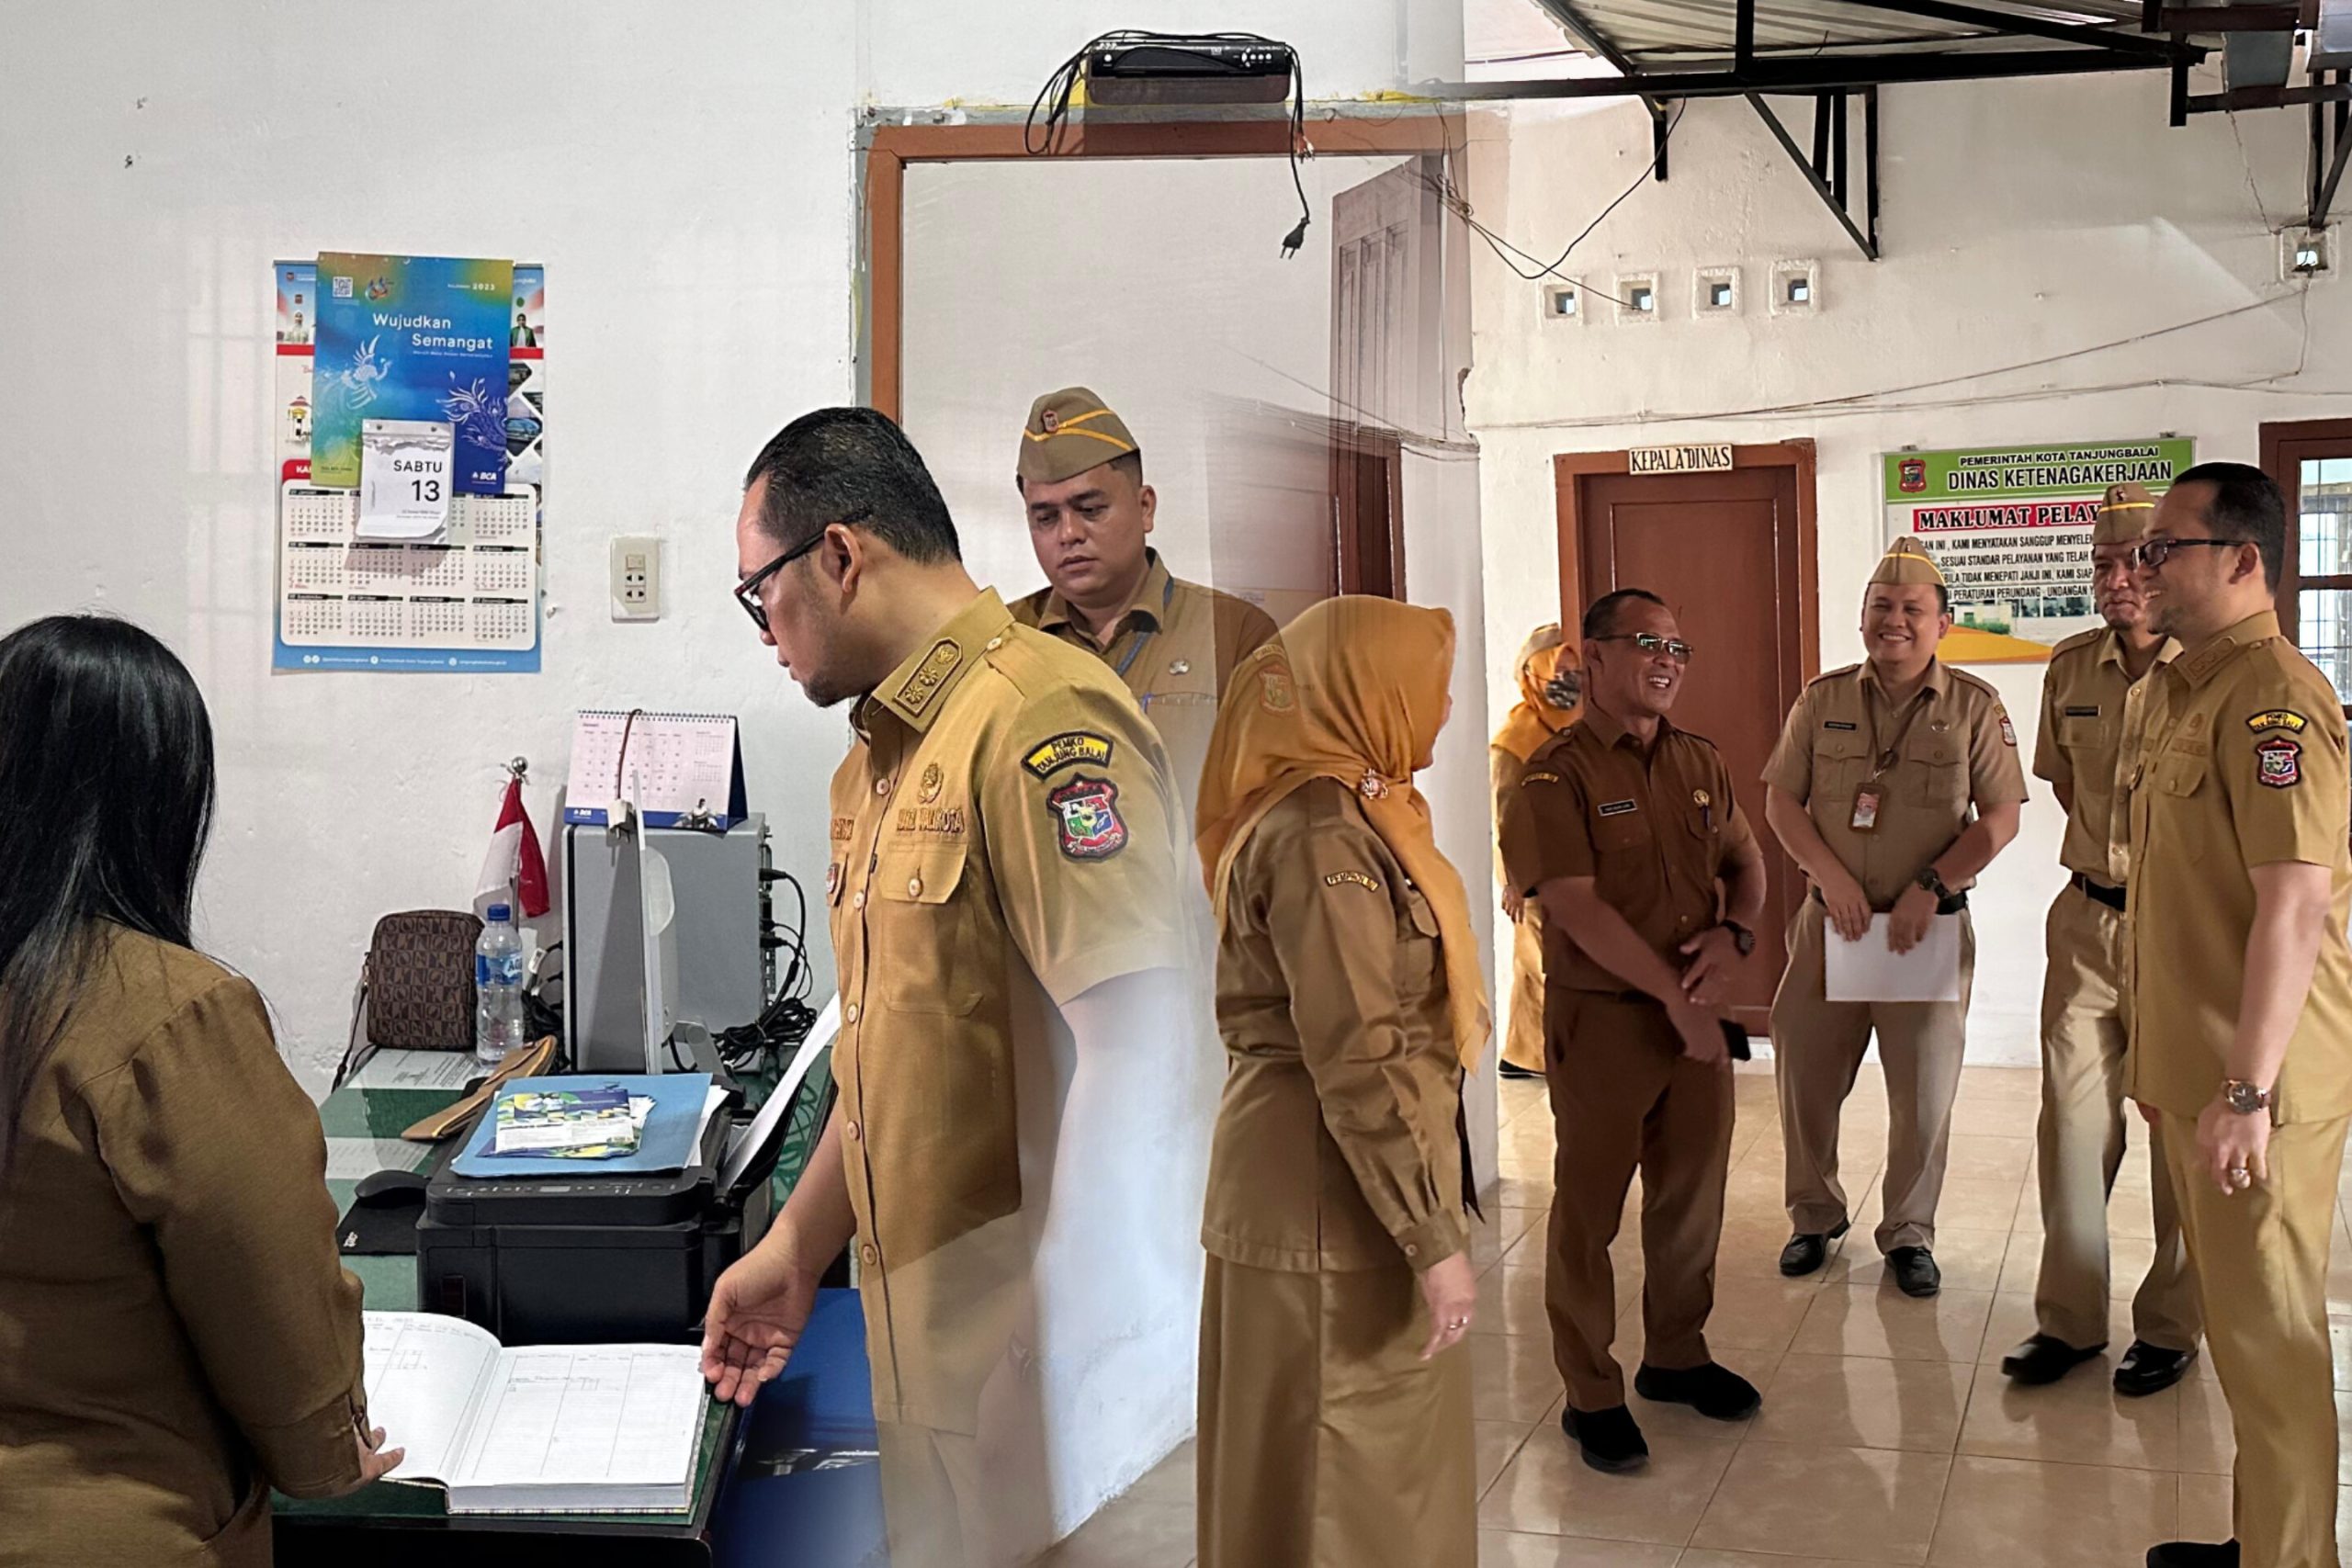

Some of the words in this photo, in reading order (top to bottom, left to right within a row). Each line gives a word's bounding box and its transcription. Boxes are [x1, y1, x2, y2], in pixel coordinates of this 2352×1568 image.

[372, 312, 451, 331] Wujudkan
[412, 333, 493, 352] Semangat
[393, 459, 442, 473] SABTU
[1631, 448, 1684, 471] KEPALA
[1685, 446, 1730, 468] DINAS
[1960, 454, 2032, 467] PEMERINTAH
[2036, 452, 2065, 462] KOTA
[2069, 447, 2158, 460] TANJUNGBALAI
[1949, 470, 1998, 490] DINAS
[2005, 461, 2171, 487] KETENAGAKERJAAN
[412, 479, 440, 502] 13
[1920, 508, 2030, 529] MAKLUMAT
[1952, 538, 1970, 550] KAMI
[1972, 536, 2018, 549] MENYATAKAN
[2019, 535, 2054, 547] SANGGUP
[1940, 556, 1966, 567] SESUAI
[1968, 555, 2000, 566] STANDAR
[2002, 553, 2043, 565] PELAYANAN
[2045, 551, 2064, 563] YANG
[2066, 550, 2089, 562] TELAH
[1962, 571, 1982, 582] TIDAK
[1984, 570, 2018, 582] MENEPATI
[2020, 570, 2040, 581] JANJI
[2057, 569, 2075, 579] KAMI
[1954, 588, 1995, 600] PERATURAN
[1997, 587, 2041, 599] PERUNDANG
[2047, 584, 2087, 597] UNDANGAN
